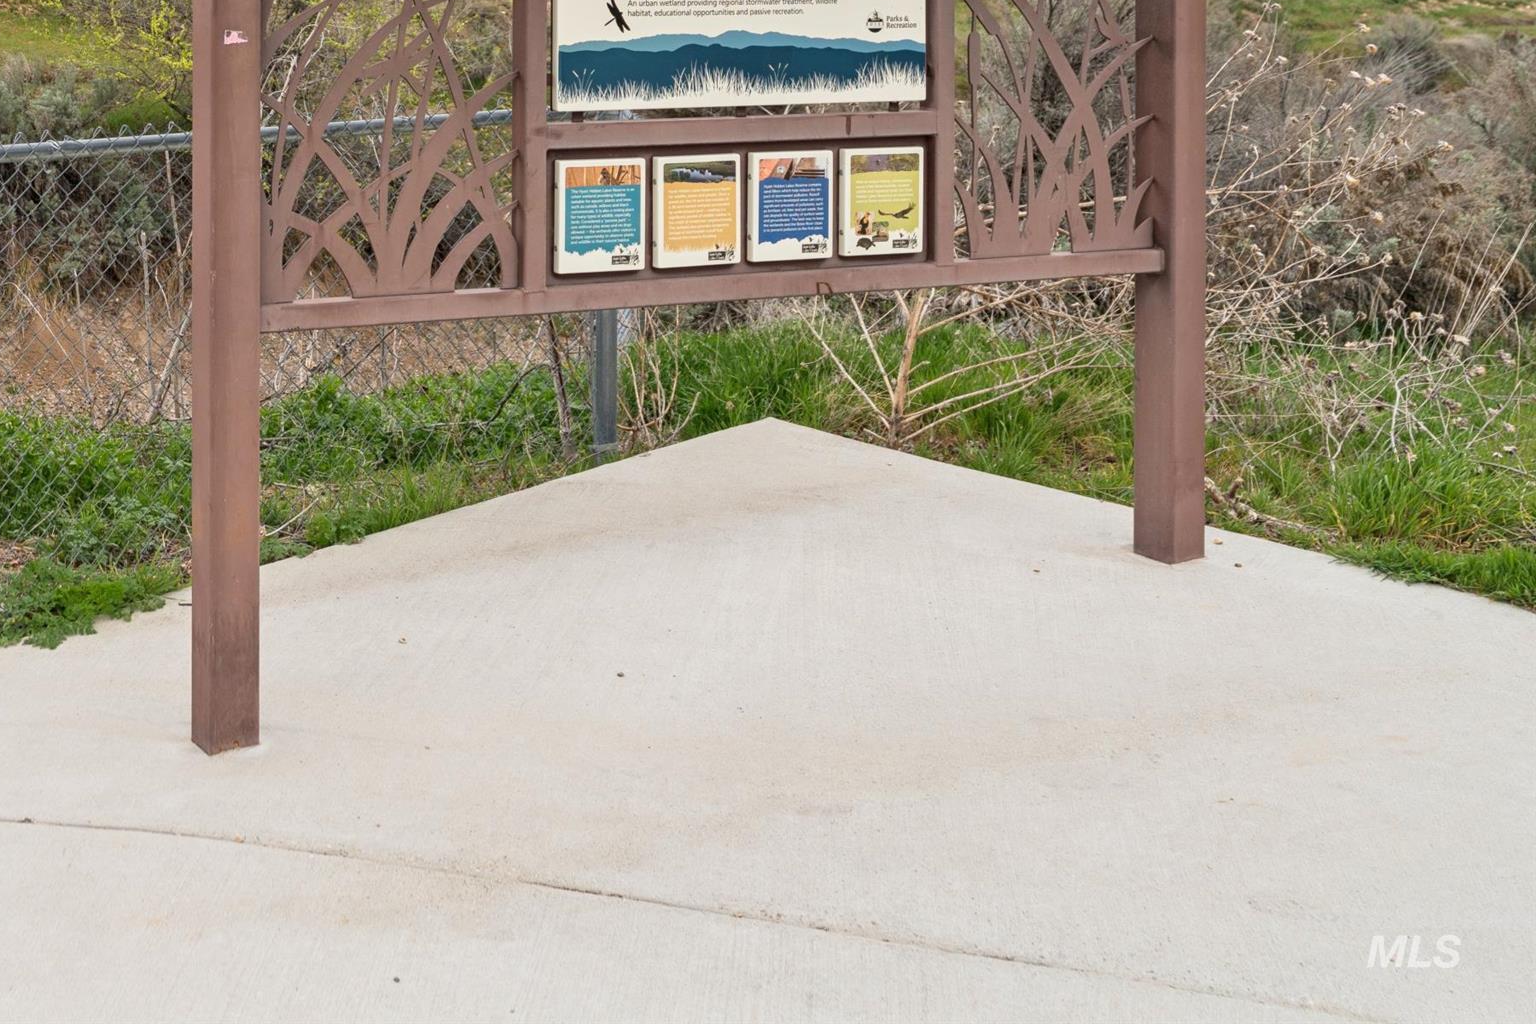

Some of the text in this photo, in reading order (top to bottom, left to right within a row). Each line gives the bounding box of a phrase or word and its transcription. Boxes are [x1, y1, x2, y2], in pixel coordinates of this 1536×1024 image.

[627, 0, 637, 7] An
[687, 0, 717, 8] providing
[627, 9, 652, 17] habitat,
[692, 8, 735, 17] opportunities
[749, 8, 771, 16] passive
